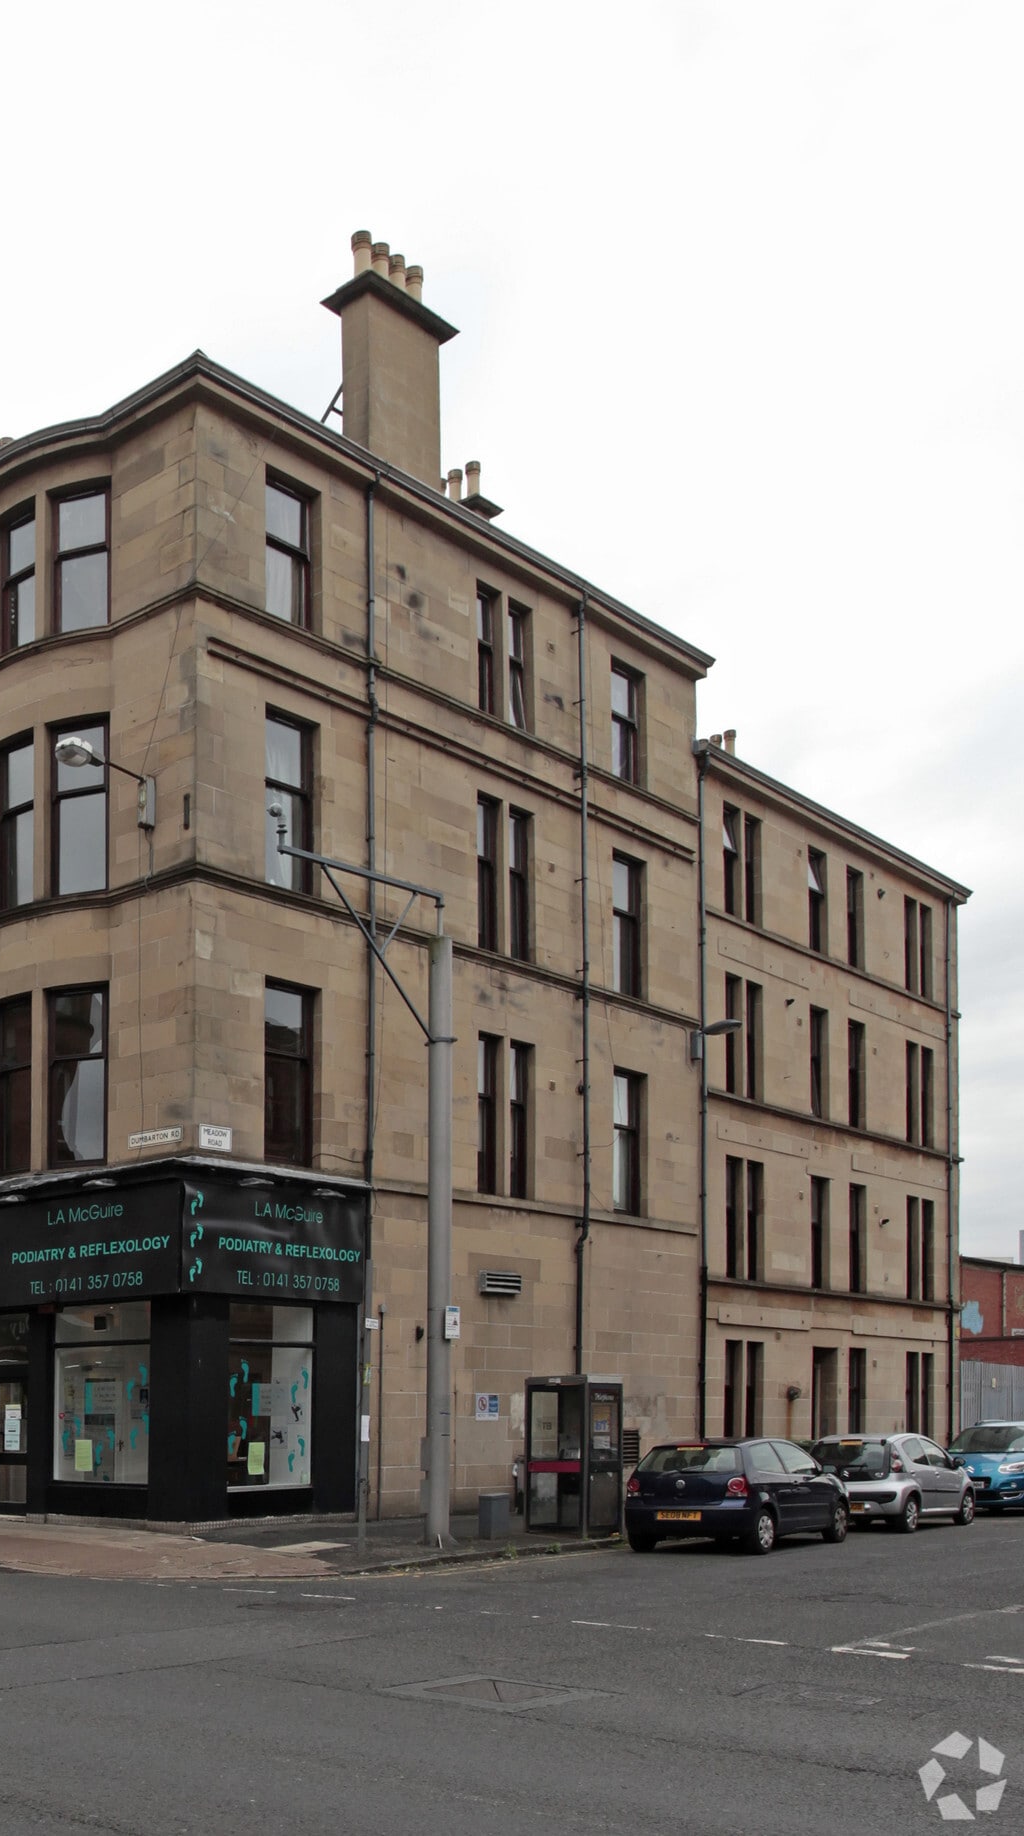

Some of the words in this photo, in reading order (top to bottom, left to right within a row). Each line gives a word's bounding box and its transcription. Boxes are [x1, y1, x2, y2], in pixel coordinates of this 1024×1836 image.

[130, 1132, 168, 1145] DUMBARTON
[203, 1128, 228, 1138] MEADOW
[208, 1138, 222, 1146] ROAD
[68, 1203, 124, 1222] McGuire
[276, 1203, 324, 1224] McGuire
[12, 1247, 65, 1264] PODIATRY
[68, 1246, 76, 1259] &
[80, 1235, 170, 1258] REFLEXOLOGY
[218, 1236, 273, 1254] PODIATRY
[274, 1242, 282, 1256] &
[286, 1243, 360, 1263] REFLEXOLOGY
[56, 1277, 82, 1292] 0141
[88, 1274, 109, 1290] 357
[112, 1271, 143, 1288] 0758
[263, 1272, 288, 1288] 0141
[292, 1274, 312, 1289] 357
[314, 1276, 340, 1292] 0758
